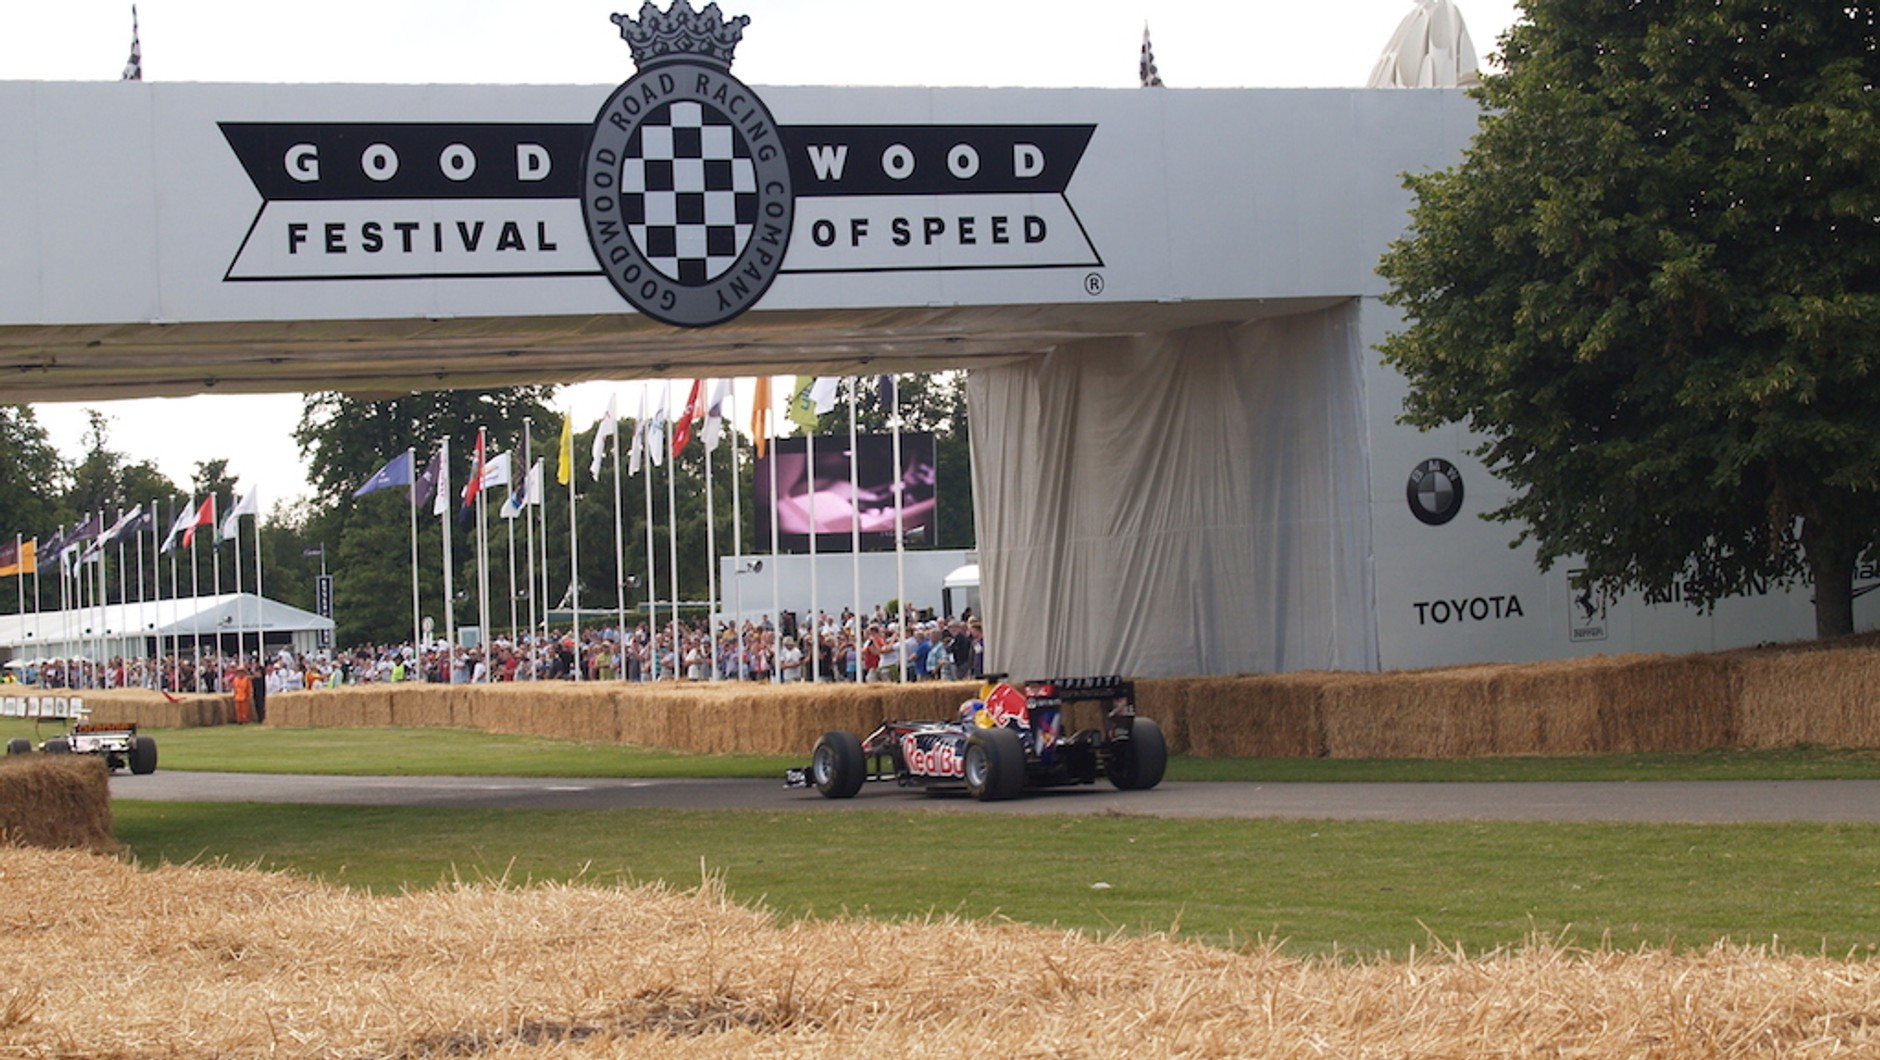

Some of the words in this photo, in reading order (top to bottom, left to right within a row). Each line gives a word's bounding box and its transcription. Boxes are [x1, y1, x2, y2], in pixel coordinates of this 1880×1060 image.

[609, 72, 675, 132] ROAD
[695, 72, 778, 163] RACING
[288, 220, 558, 254] FESTIVAL
[593, 147, 677, 312] GOODWOOD
[716, 180, 785, 312] COMPANY
[811, 218, 869, 247] OF
[891, 215, 1048, 246] SPEED
[1411, 460, 1460, 483] BMW
[1413, 594, 1524, 625] TOYOTA
[904, 735, 941, 774] Red
